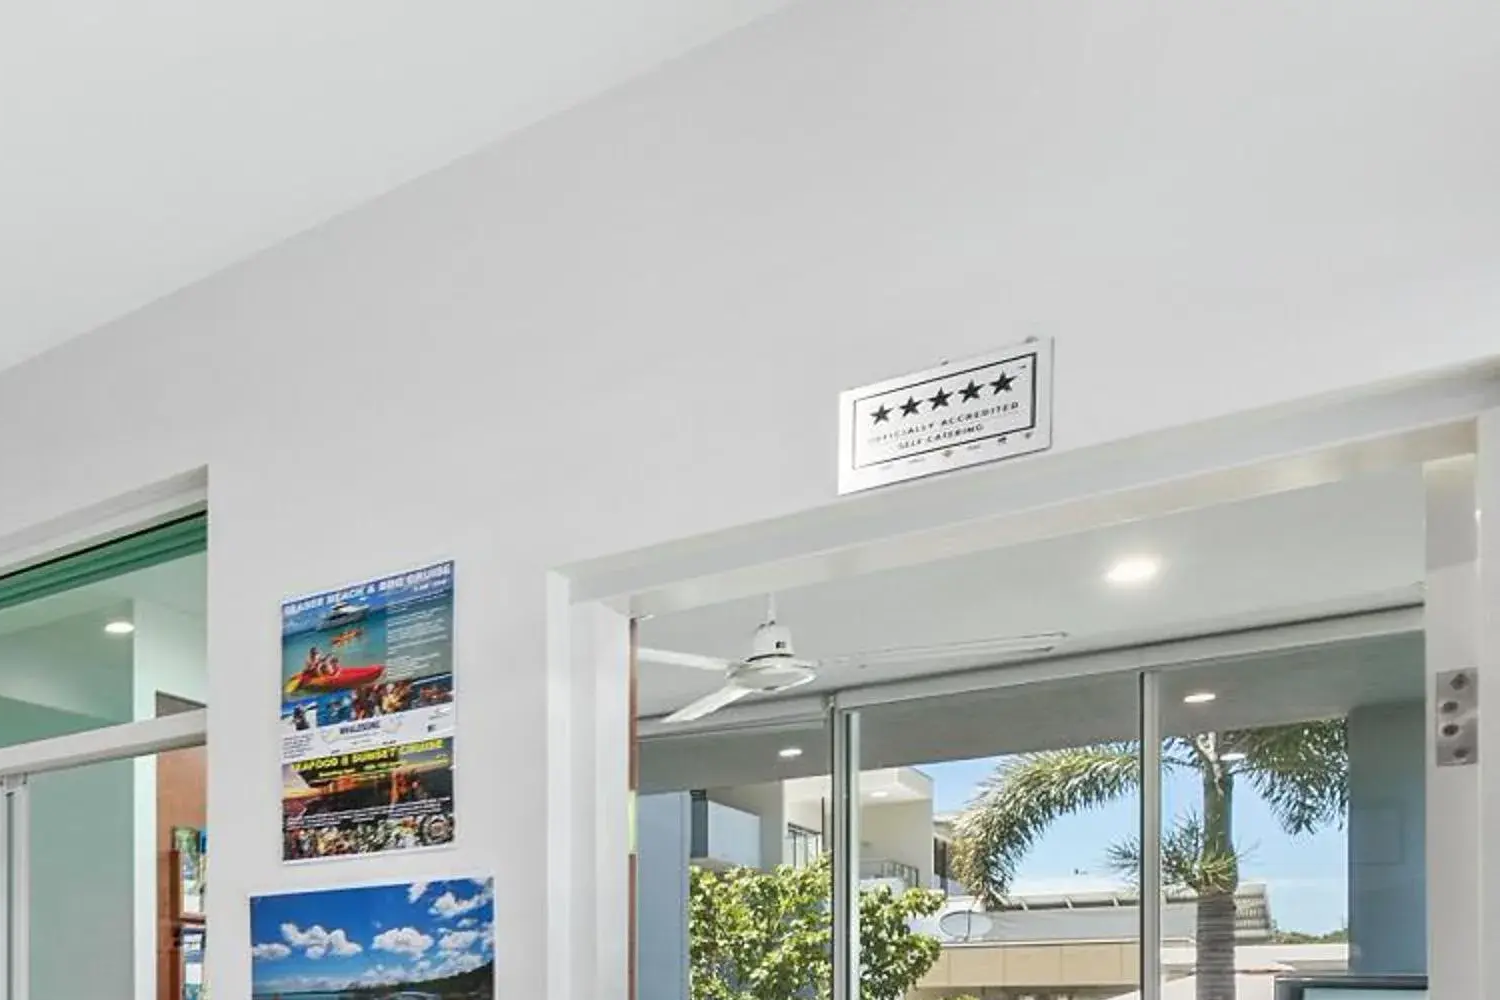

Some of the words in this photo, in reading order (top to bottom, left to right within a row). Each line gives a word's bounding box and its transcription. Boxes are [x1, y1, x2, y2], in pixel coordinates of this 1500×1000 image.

[941, 402, 1019, 427] ACCREDITED
[927, 424, 984, 444] CATERING
[406, 563, 451, 586] CRUISE
[352, 747, 396, 763] SUNSET
